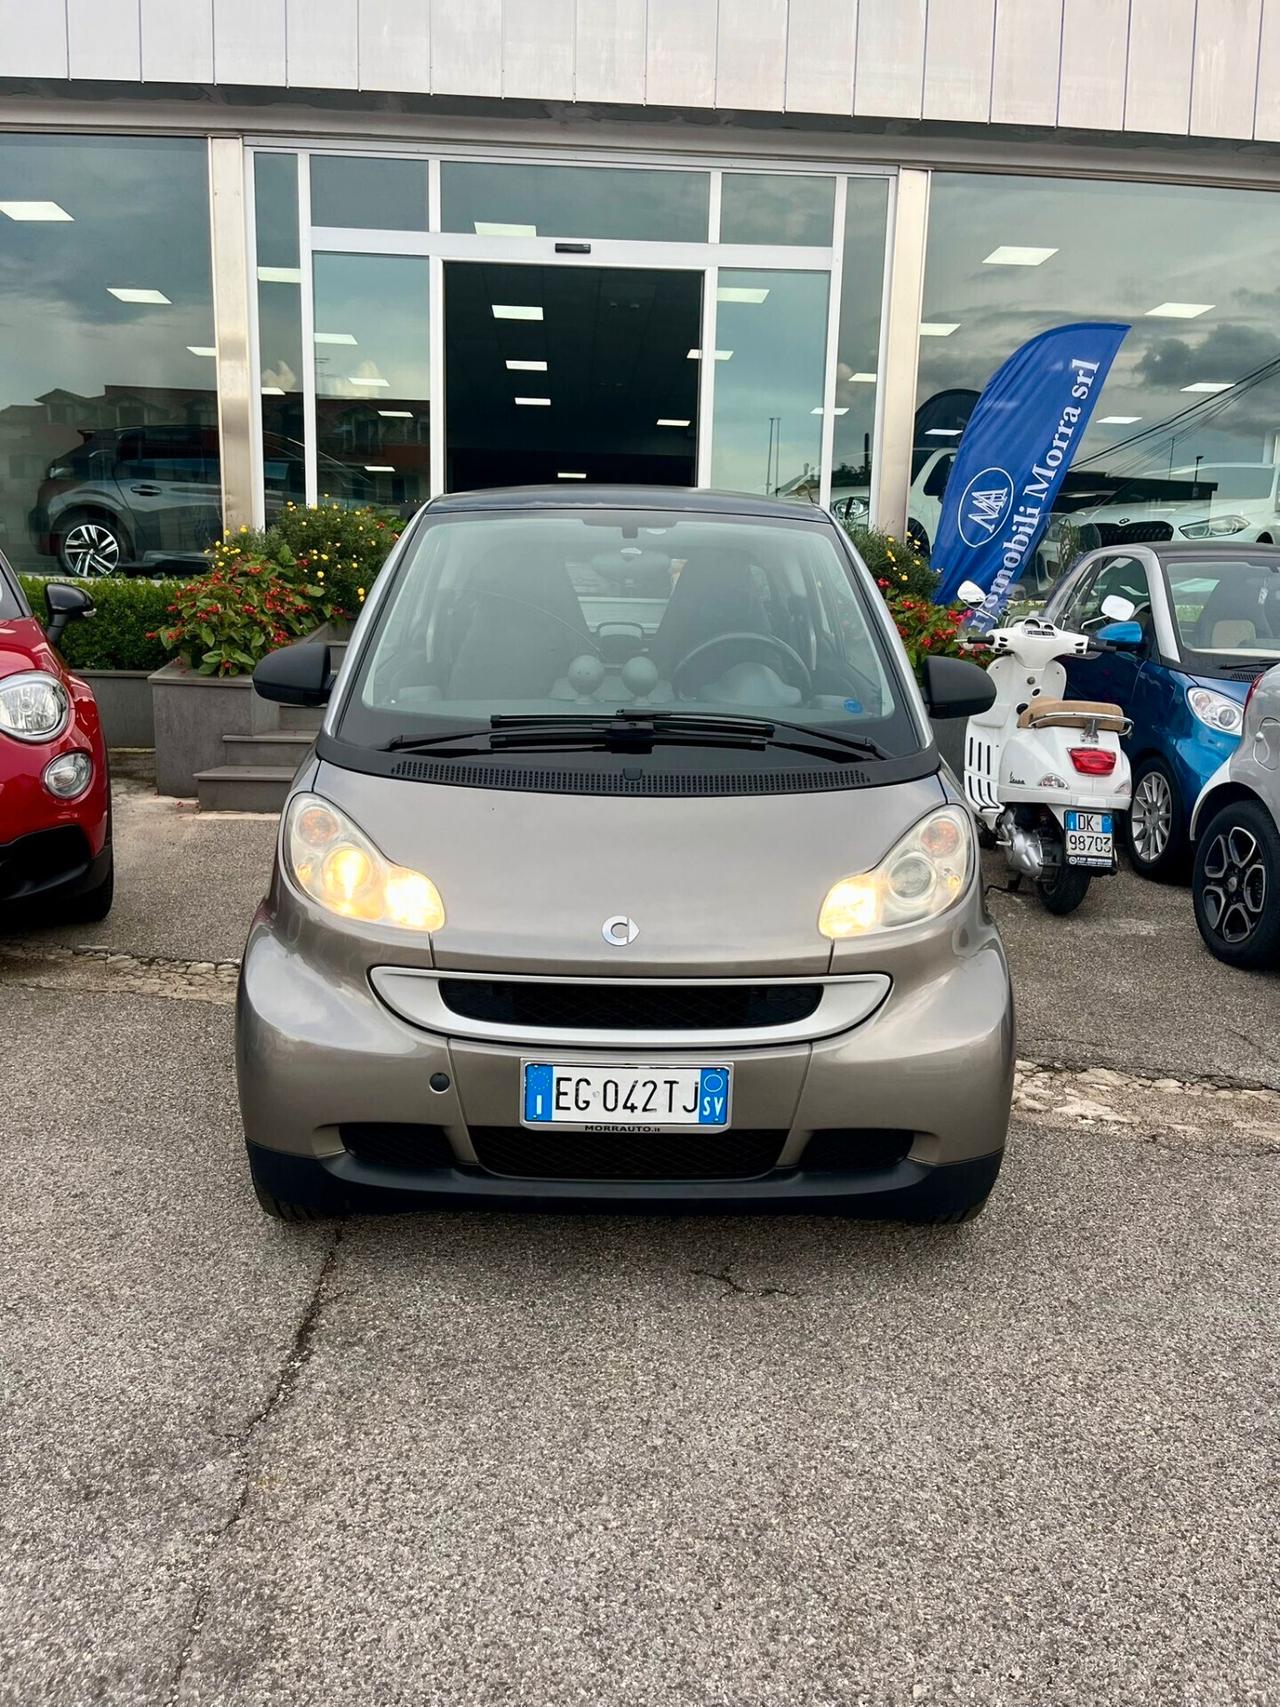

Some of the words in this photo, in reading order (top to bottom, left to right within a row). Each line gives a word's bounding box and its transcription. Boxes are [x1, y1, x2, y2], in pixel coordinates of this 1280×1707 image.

[1022, 403, 1081, 499] Morra
[1071, 358, 1101, 400] srl
[1077, 814, 1095, 831] DK
[1069, 834, 1112, 853] 98703
[555, 1077, 592, 1112] EG
[702, 1096, 724, 1116] SV
